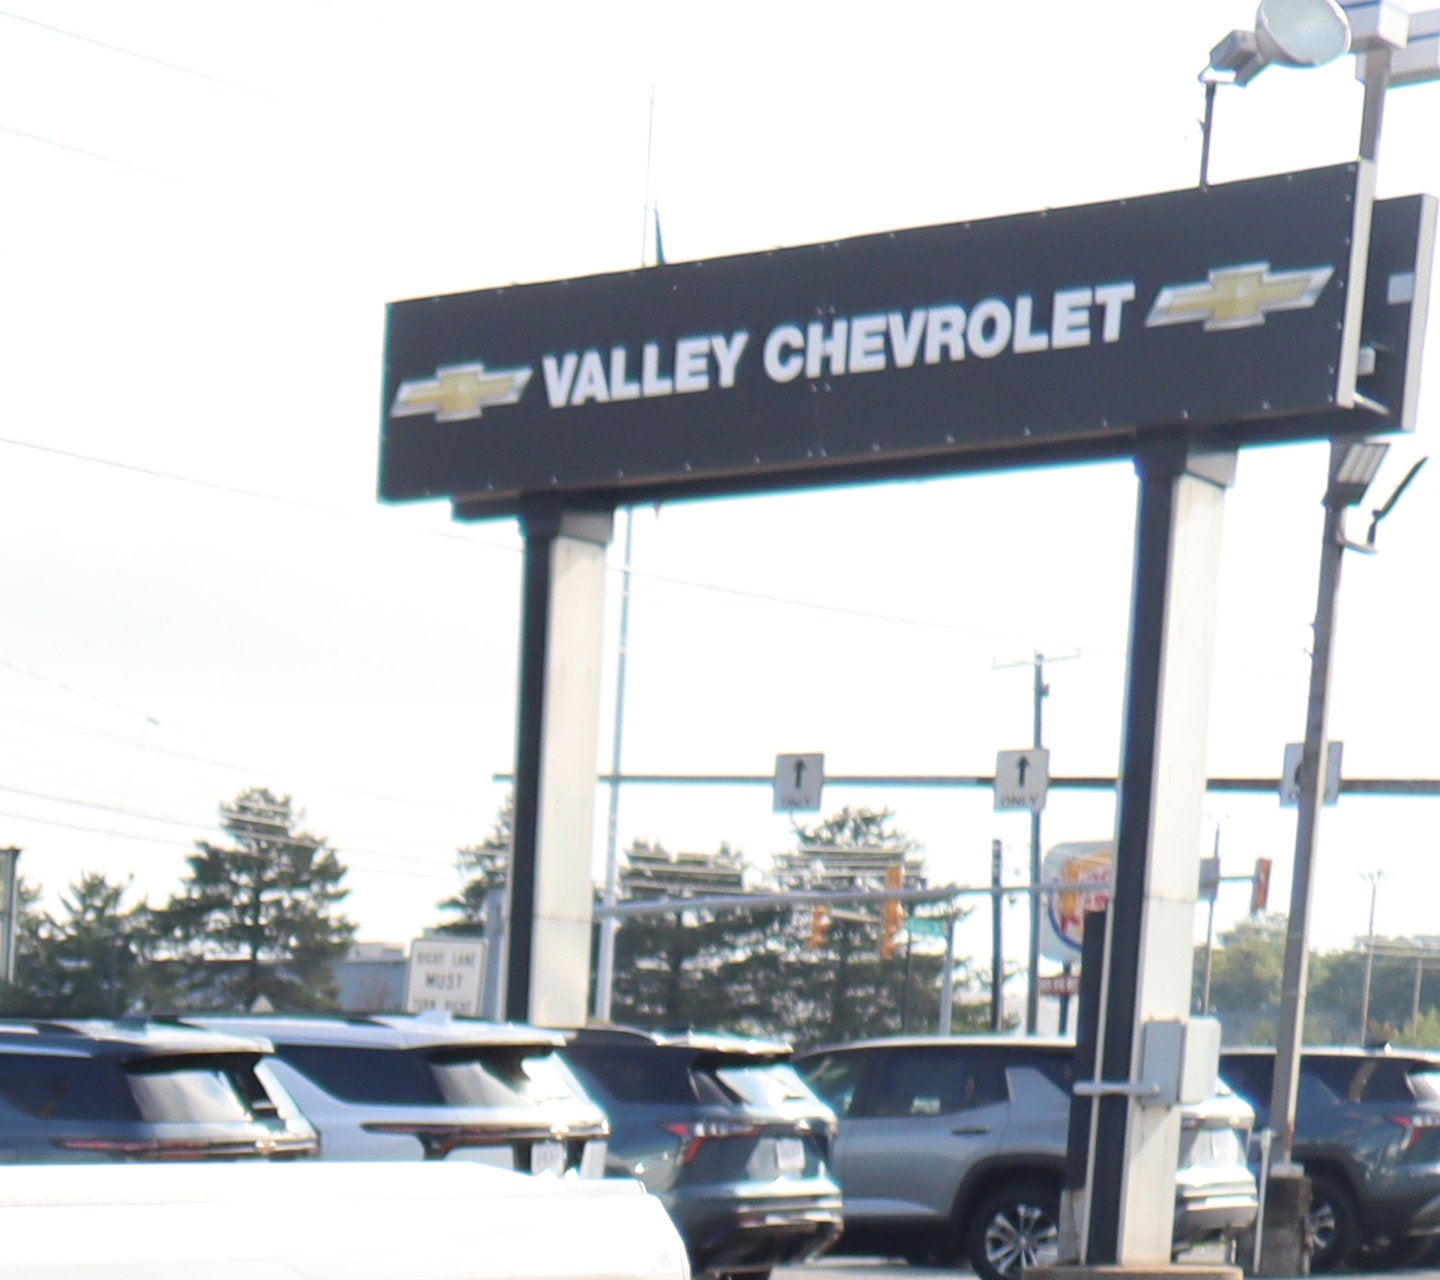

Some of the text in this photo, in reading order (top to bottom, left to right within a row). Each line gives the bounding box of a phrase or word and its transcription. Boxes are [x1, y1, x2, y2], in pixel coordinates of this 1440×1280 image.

[542, 282, 1136, 409] VALLEY CHEVROLET
[1000, 794, 1039, 807] ONLY
[425, 972, 463, 990] MUST
